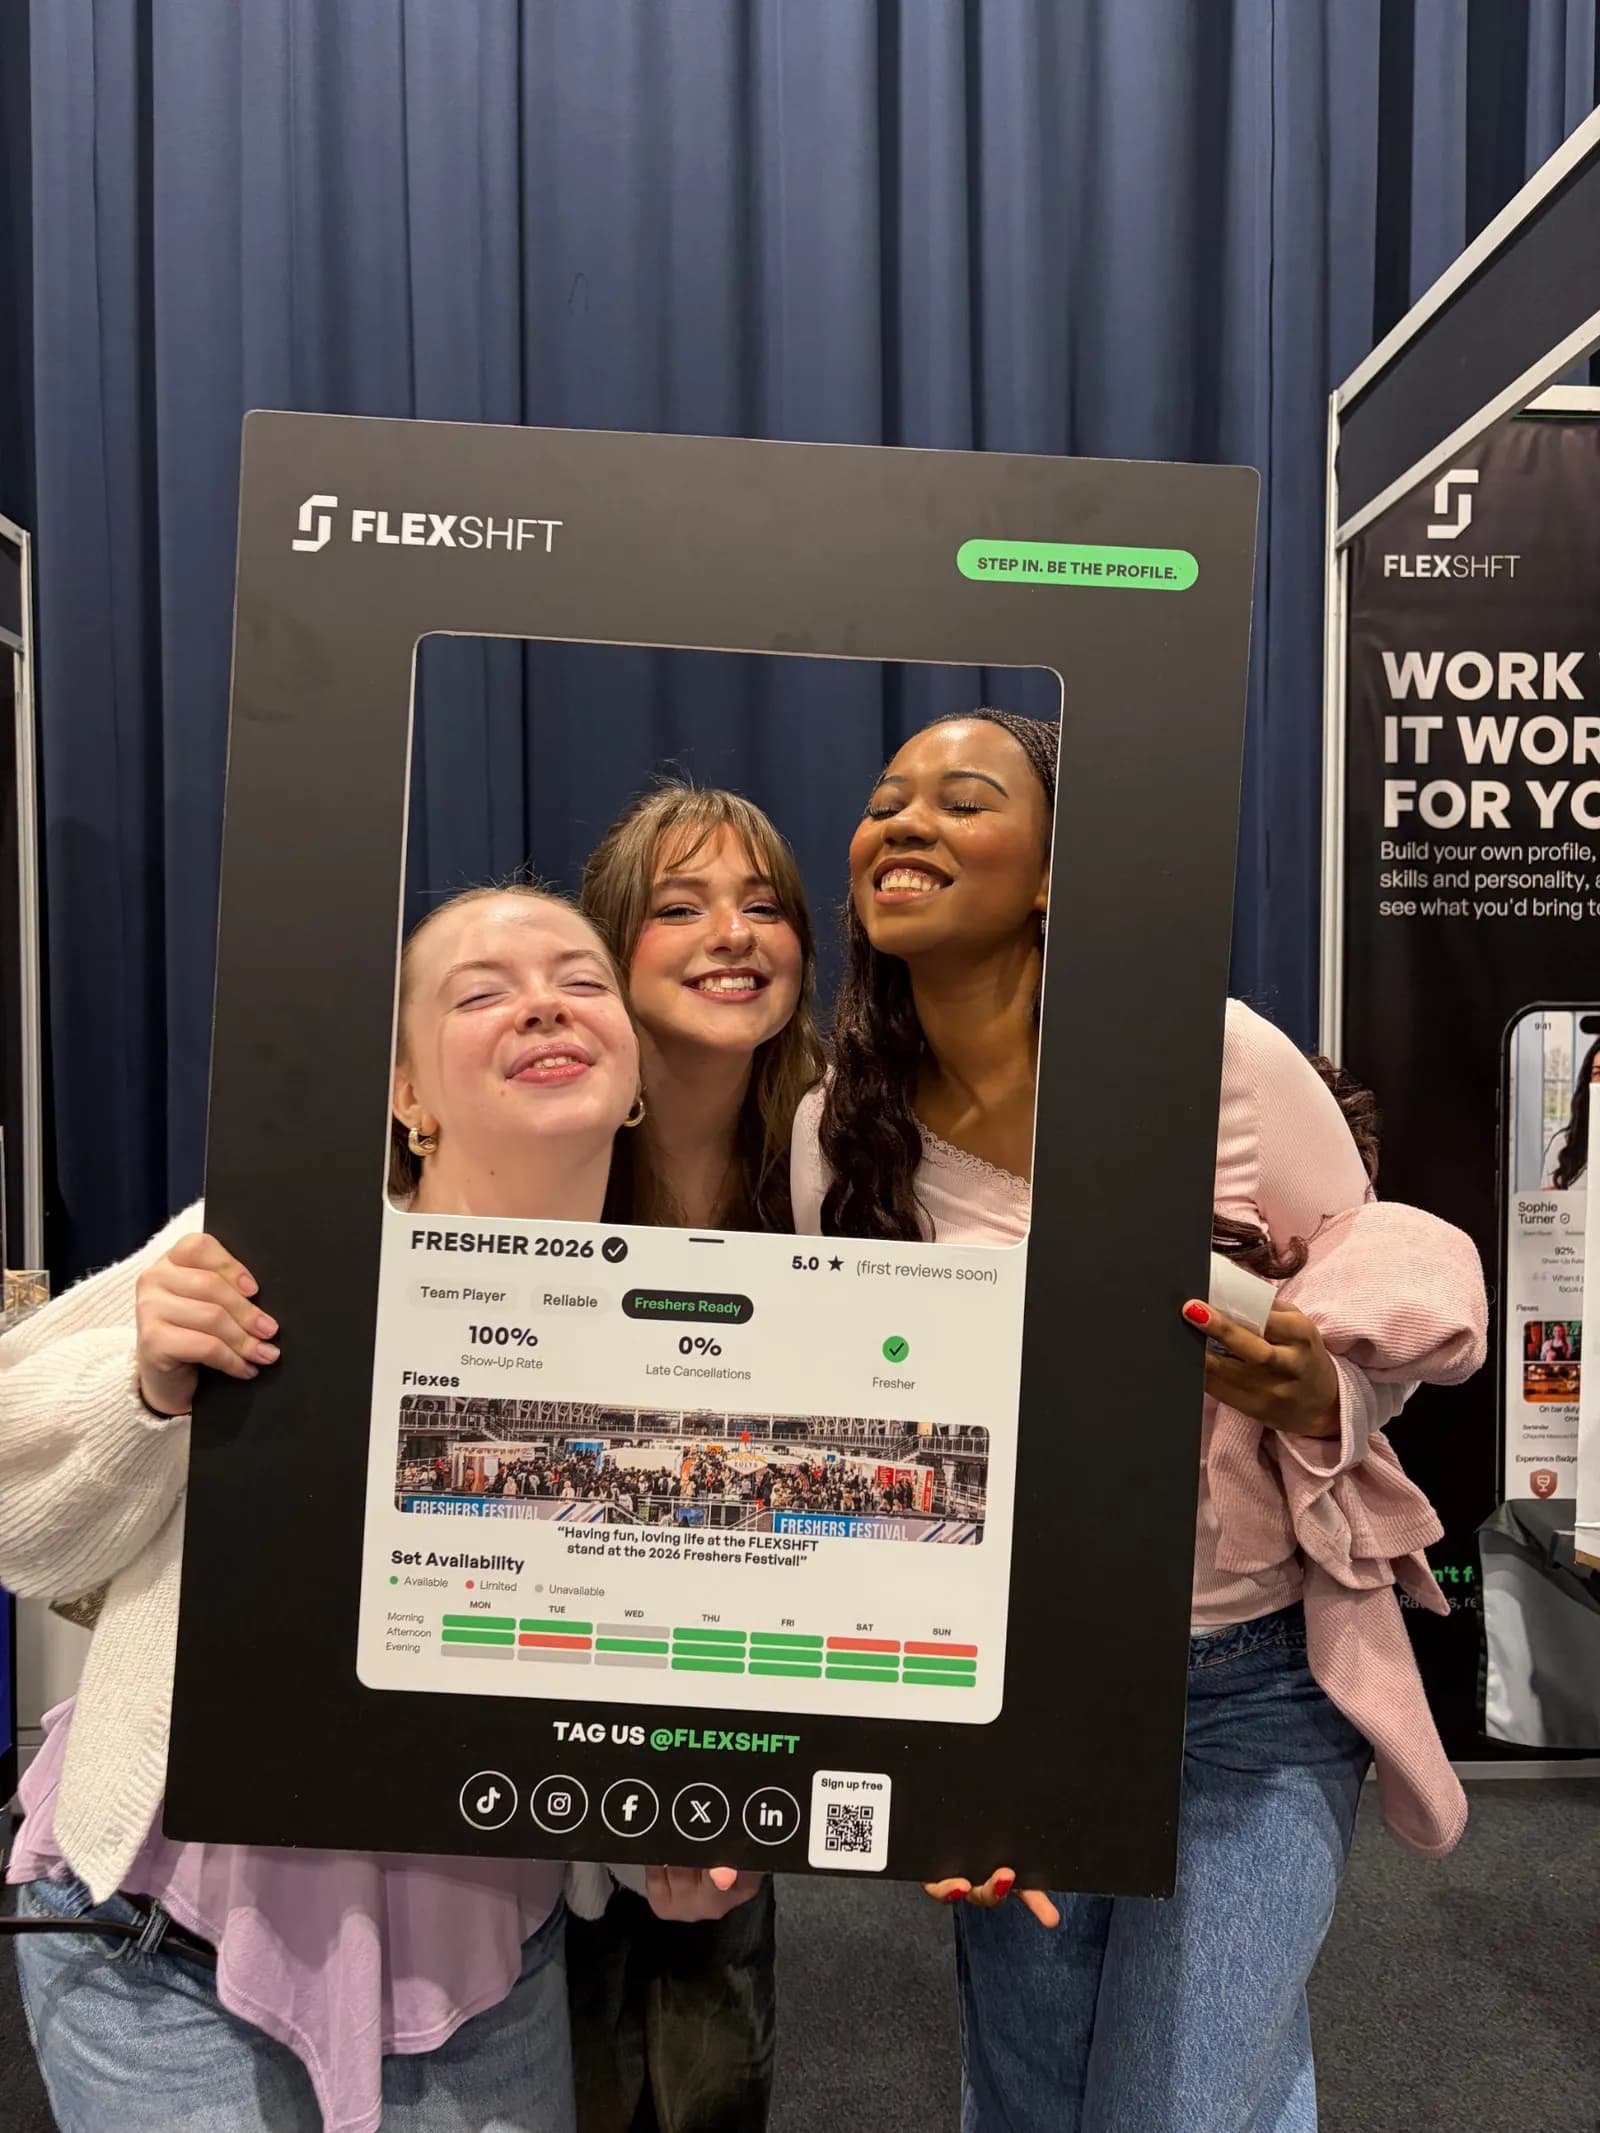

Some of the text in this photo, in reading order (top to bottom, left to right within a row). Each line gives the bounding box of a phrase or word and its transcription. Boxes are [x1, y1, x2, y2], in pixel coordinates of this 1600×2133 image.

[351, 509, 563, 553] FLEXSHFT
[977, 557, 1177, 579] STEP IN. BE THE PROFILE.
[1383, 554, 1520, 578] FLEXSHFT
[1382, 652, 1585, 700] WORK
[1384, 715, 1600, 765] IT WOR
[1383, 779, 1511, 830] FOR
[1380, 841, 1596, 864] Build your own profile,
[1380, 870, 1429, 888] skills
[1433, 870, 1469, 888] and
[1474, 870, 1590, 893] personality,
[1379, 900, 1416, 916] see
[1420, 898, 1469, 916] what
[1473, 898, 1527, 920] you'd
[1532, 898, 1583, 920] bring
[1518, 1201, 1558, 1214] Sophie
[1518, 1213, 1555, 1224] Turner
[411, 1230, 594, 1258] FRESHER 2026
[792, 1256, 998, 1285] 5.0 (first reviews soon)
[420, 1286, 506, 1303] Team Player
[543, 1294, 598, 1308] Reliable
[634, 1296, 742, 1316] Freshers Ready
[468, 1325, 538, 1347] 100%
[678, 1336, 722, 1357] 0%
[460, 1354, 543, 1370] Show-Up Rate
[402, 1371, 460, 1388] Flexes
[645, 1364, 751, 1380] Late Cancellations
[872, 1377, 916, 1390] Fresher
[413, 1500, 539, 1520] FRESHERS FESTIVAL
[780, 1518, 908, 1541] FRESHERS FESTIVAL
[613, 1529, 638, 1543] fun,
[641, 1531, 681, 1546] loving
[684, 1533, 704, 1545] life
[707, 1535, 721, 1547] at
[723, 1535, 746, 1548] the
[748, 1537, 819, 1552] FLEXSHFT
[391, 1550, 525, 1575] Set Availability
[567, 1544, 605, 1556] stand
[608, 1546, 621, 1557] at
[624, 1546, 646, 1558] the
[649, 1548, 681, 1560] 2026
[684, 1549, 742, 1564] Freshers
[404, 1576, 448, 1588] Available
[480, 1580, 517, 1592] Limited
[549, 1584, 605, 1597] Unavailable
[469, 1601, 491, 1609] MON
[548, 1605, 566, 1614] TUE
[624, 1609, 644, 1618] WED
[387, 1611, 425, 1624] Morning
[701, 1614, 720, 1623] THU
[781, 1618, 795, 1627] FRI
[386, 1626, 432, 1638] Afternoon
[856, 1623, 874, 1632] SAT
[932, 1628, 951, 1636] SUN
[386, 1642, 421, 1654] Evening
[552, 1721, 800, 1754] TAG US @FLEXSHFT
[821, 1777, 884, 1792] Sign up free
